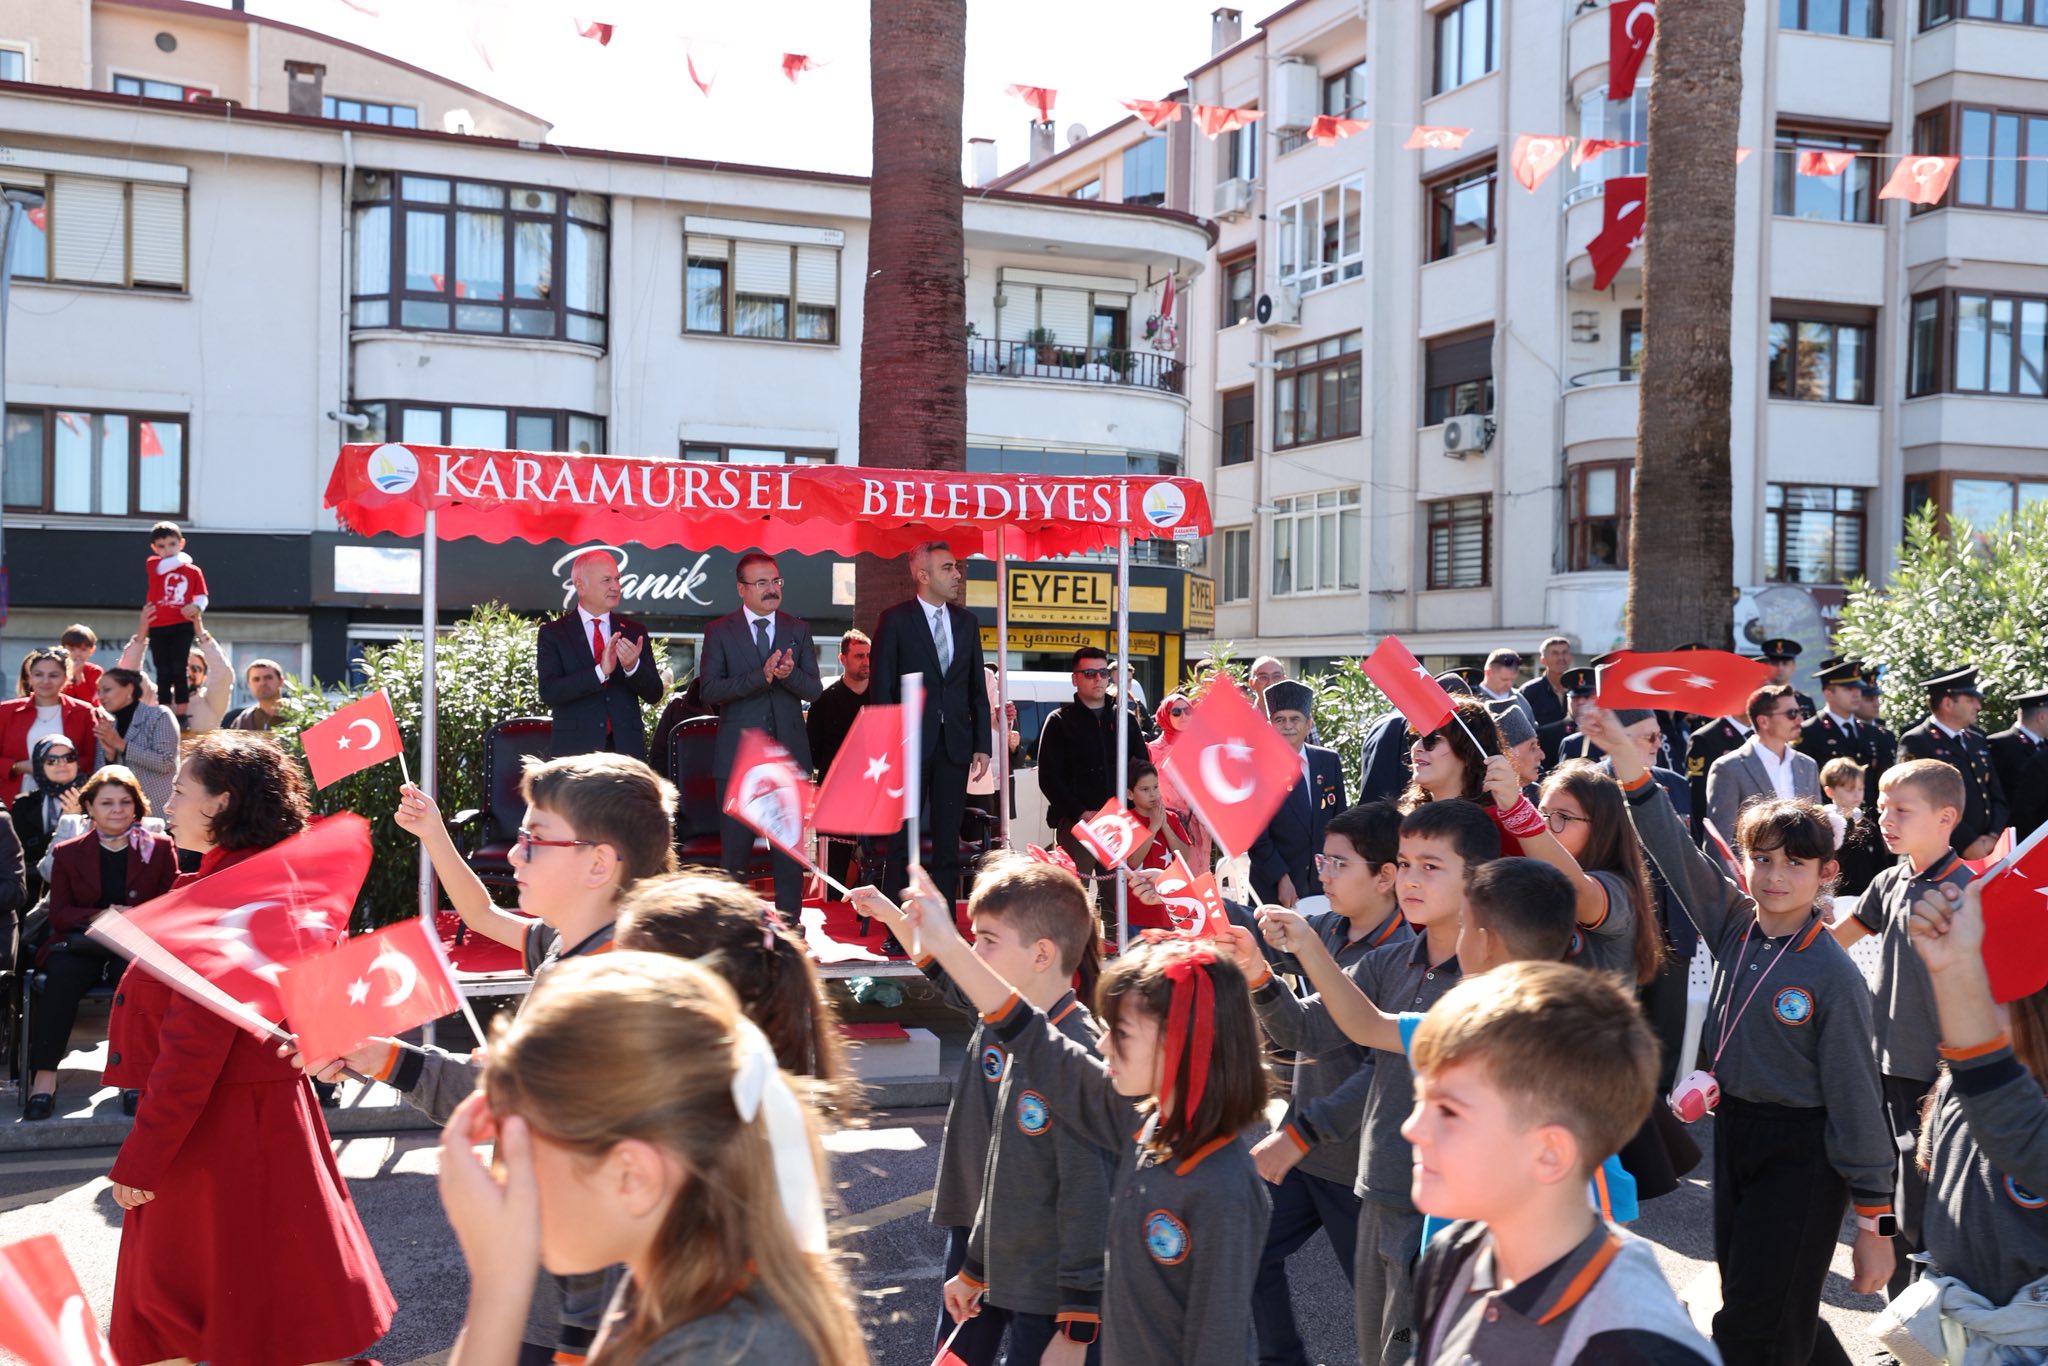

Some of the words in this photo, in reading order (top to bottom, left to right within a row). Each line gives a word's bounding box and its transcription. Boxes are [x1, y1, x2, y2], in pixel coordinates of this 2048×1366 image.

[434, 453, 802, 511] KARAMURSEL
[859, 477, 1133, 523] BELEDİYESİ
[1011, 573, 1107, 605] EYFEL
[1191, 580, 1213, 610] EYFEL
[1062, 614, 1108, 622] PARFUM
[1023, 632, 1091, 649] yanında
[1203, 887, 1222, 919] ATA
